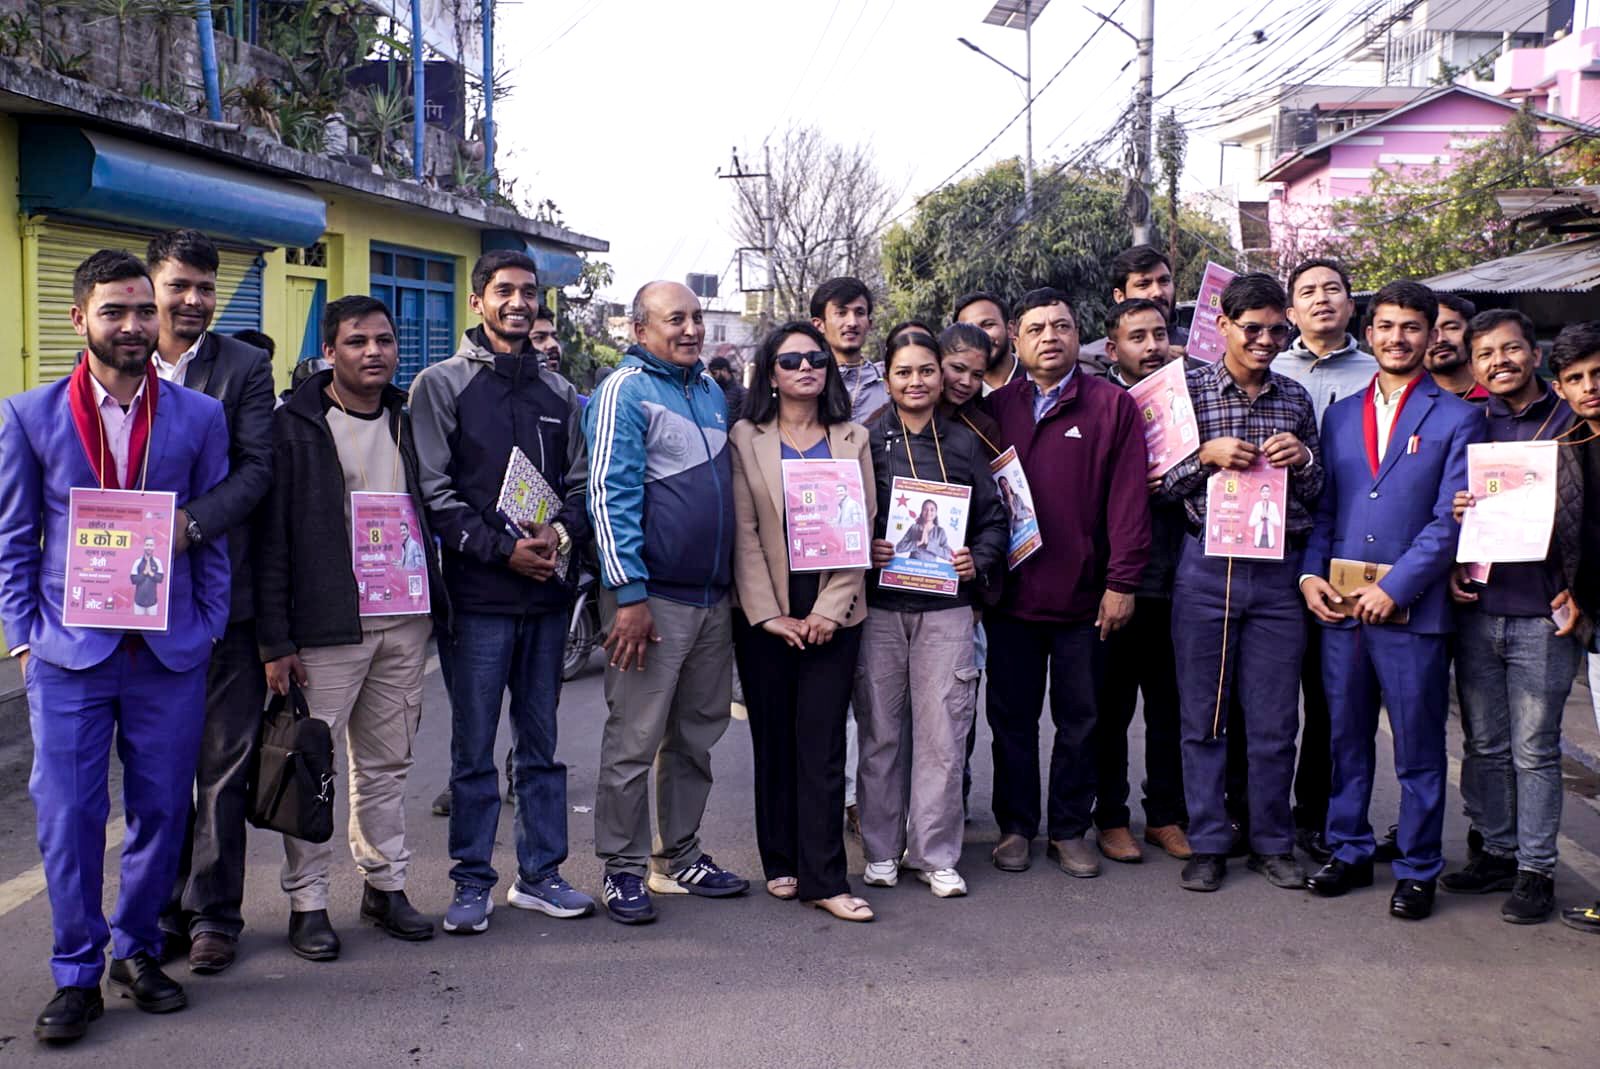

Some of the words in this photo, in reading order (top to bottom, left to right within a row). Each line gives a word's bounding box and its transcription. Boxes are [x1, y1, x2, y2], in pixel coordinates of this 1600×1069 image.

[79, 533, 88, 545] ४
[94, 530, 112, 546] को
[116, 535, 128, 547] ग
